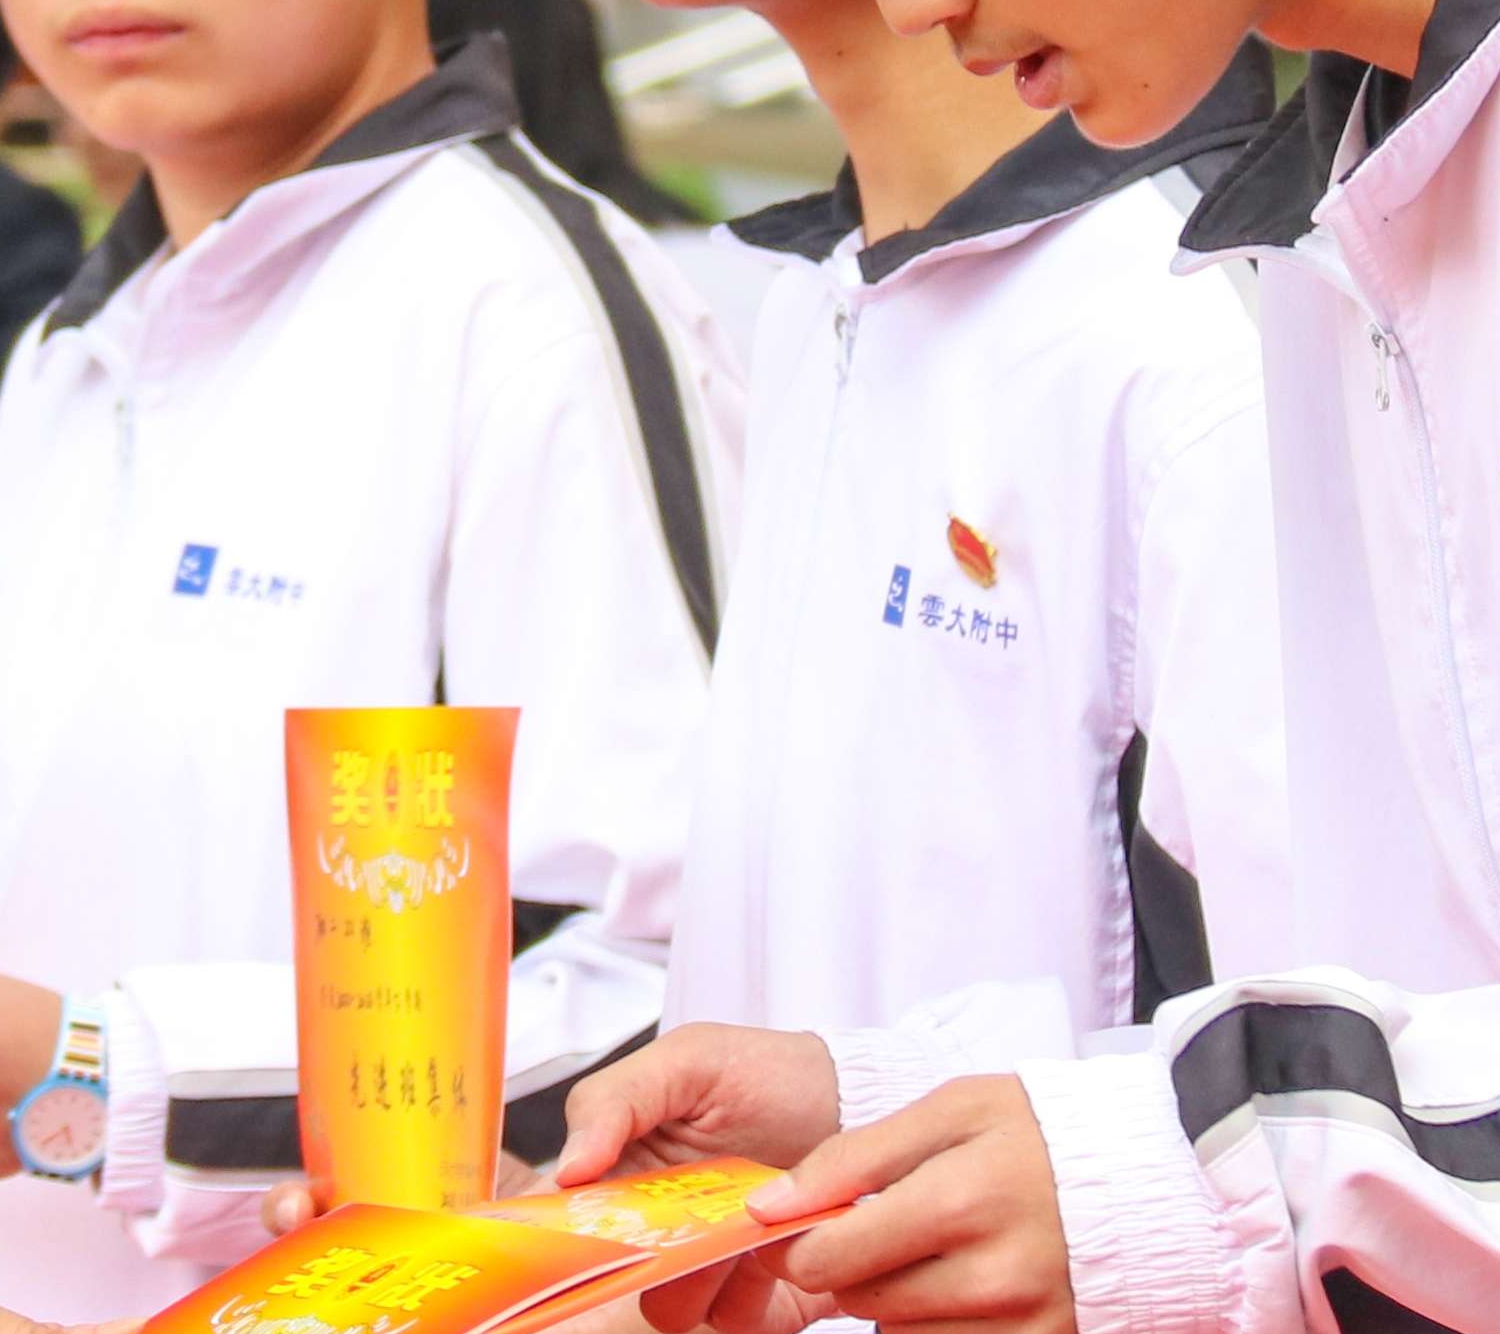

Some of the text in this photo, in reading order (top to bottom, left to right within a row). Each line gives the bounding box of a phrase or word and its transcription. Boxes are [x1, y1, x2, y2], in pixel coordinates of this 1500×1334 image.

[917, 594, 1019, 649] 雲大附中
[328, 749, 456, 828] 奖状
[266, 1245, 481, 1312] 奖状
